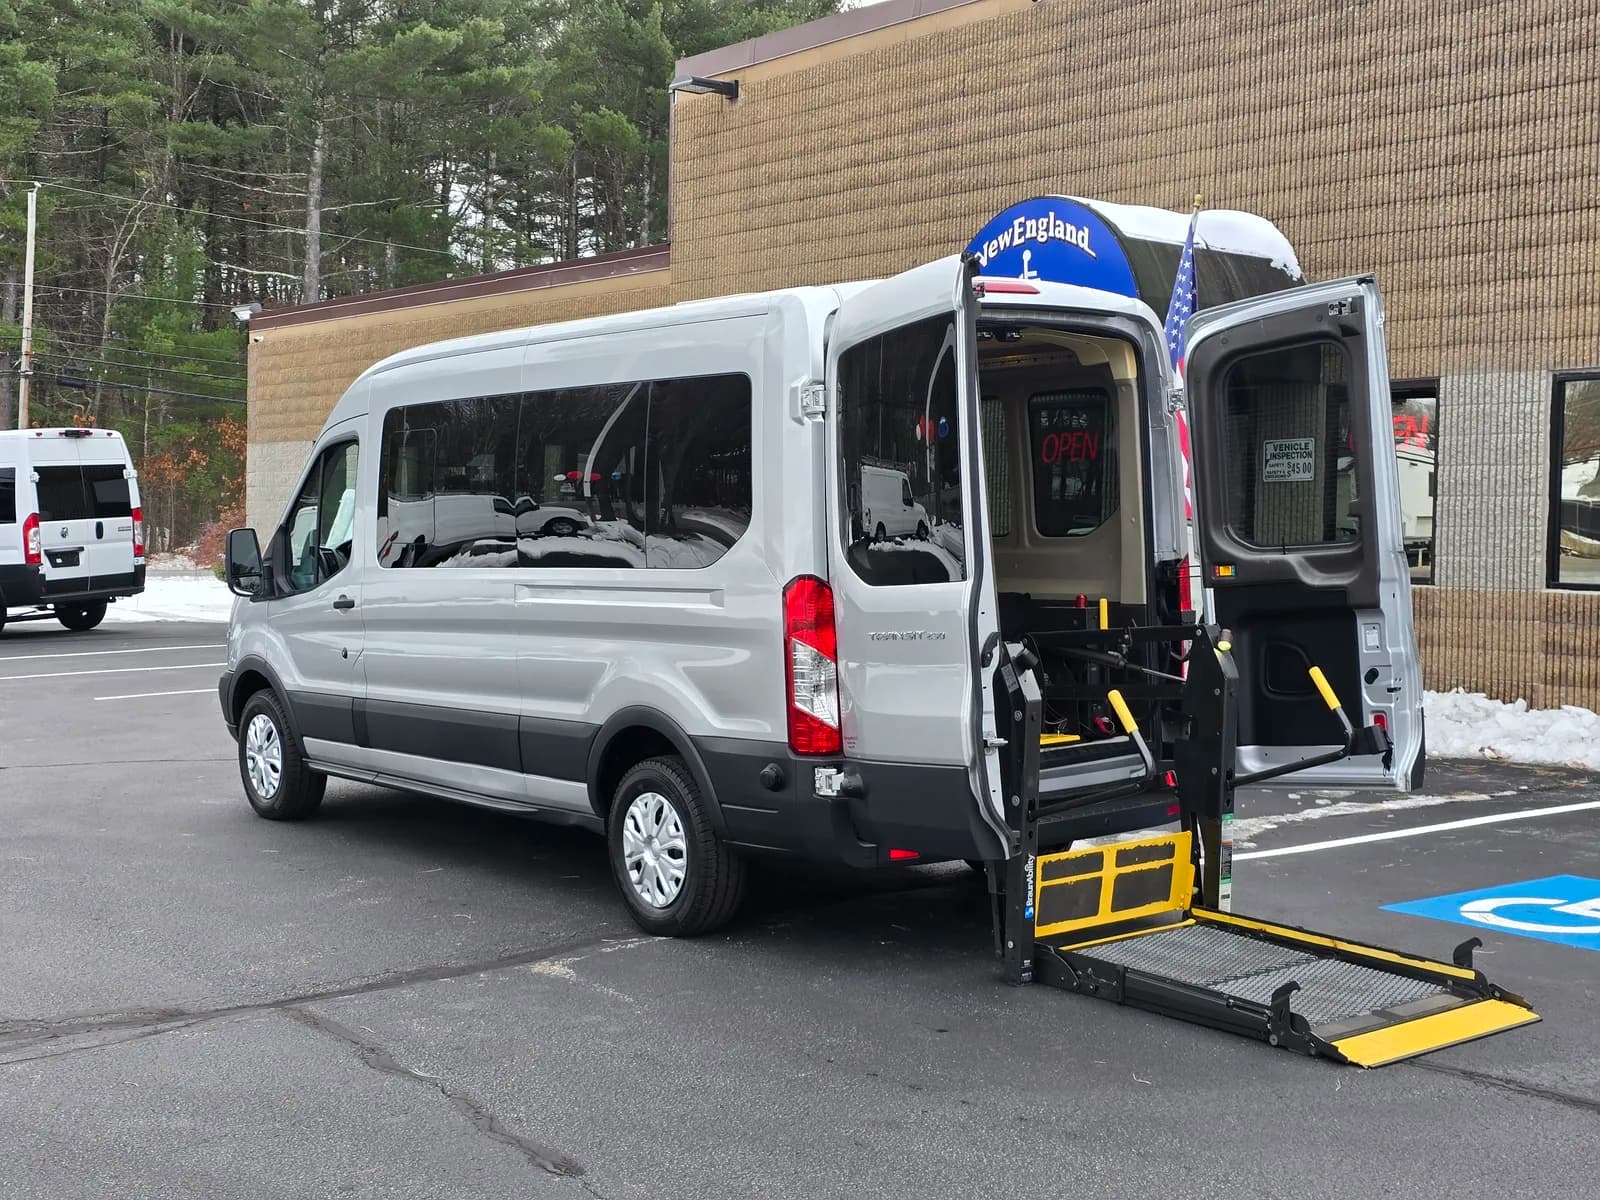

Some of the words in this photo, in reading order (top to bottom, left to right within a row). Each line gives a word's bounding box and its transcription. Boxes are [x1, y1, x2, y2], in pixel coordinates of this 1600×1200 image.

[1042, 431, 1100, 464] OPEN
[1269, 451, 1312, 460] INSPECTION
[1273, 442, 1310, 451] VEHICLE
[1024, 853, 1036, 907] BraunAbility
